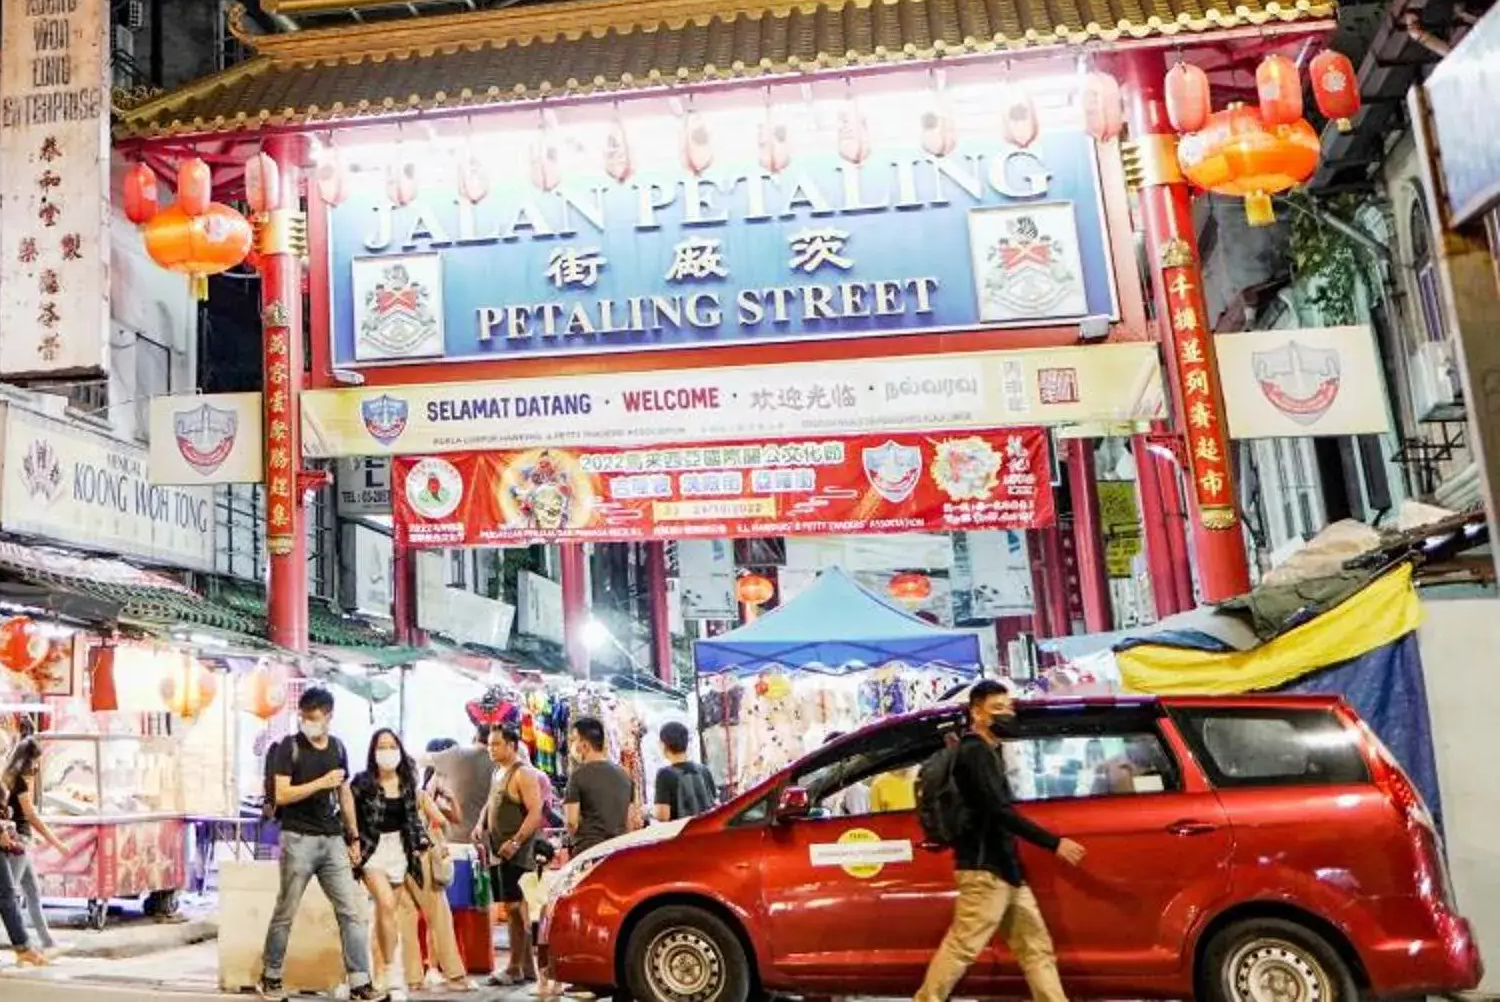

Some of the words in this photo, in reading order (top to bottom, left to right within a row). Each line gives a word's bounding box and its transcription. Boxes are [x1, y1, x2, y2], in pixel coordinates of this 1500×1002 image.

[363, 186, 608, 254] JALAN
[630, 149, 1054, 233] PETALING
[476, 295, 723, 344] PETALING
[738, 276, 938, 327] STREET
[427, 397, 509, 422] SELAMAT
[515, 393, 591, 418] DATANG
[622, 387, 720, 412] WELCOME
[750, 383, 857, 411] 欢迎光临
[73, 461, 128, 513] KOONG
[135, 479, 169, 523] WOH
[175, 492, 208, 533] TONG
